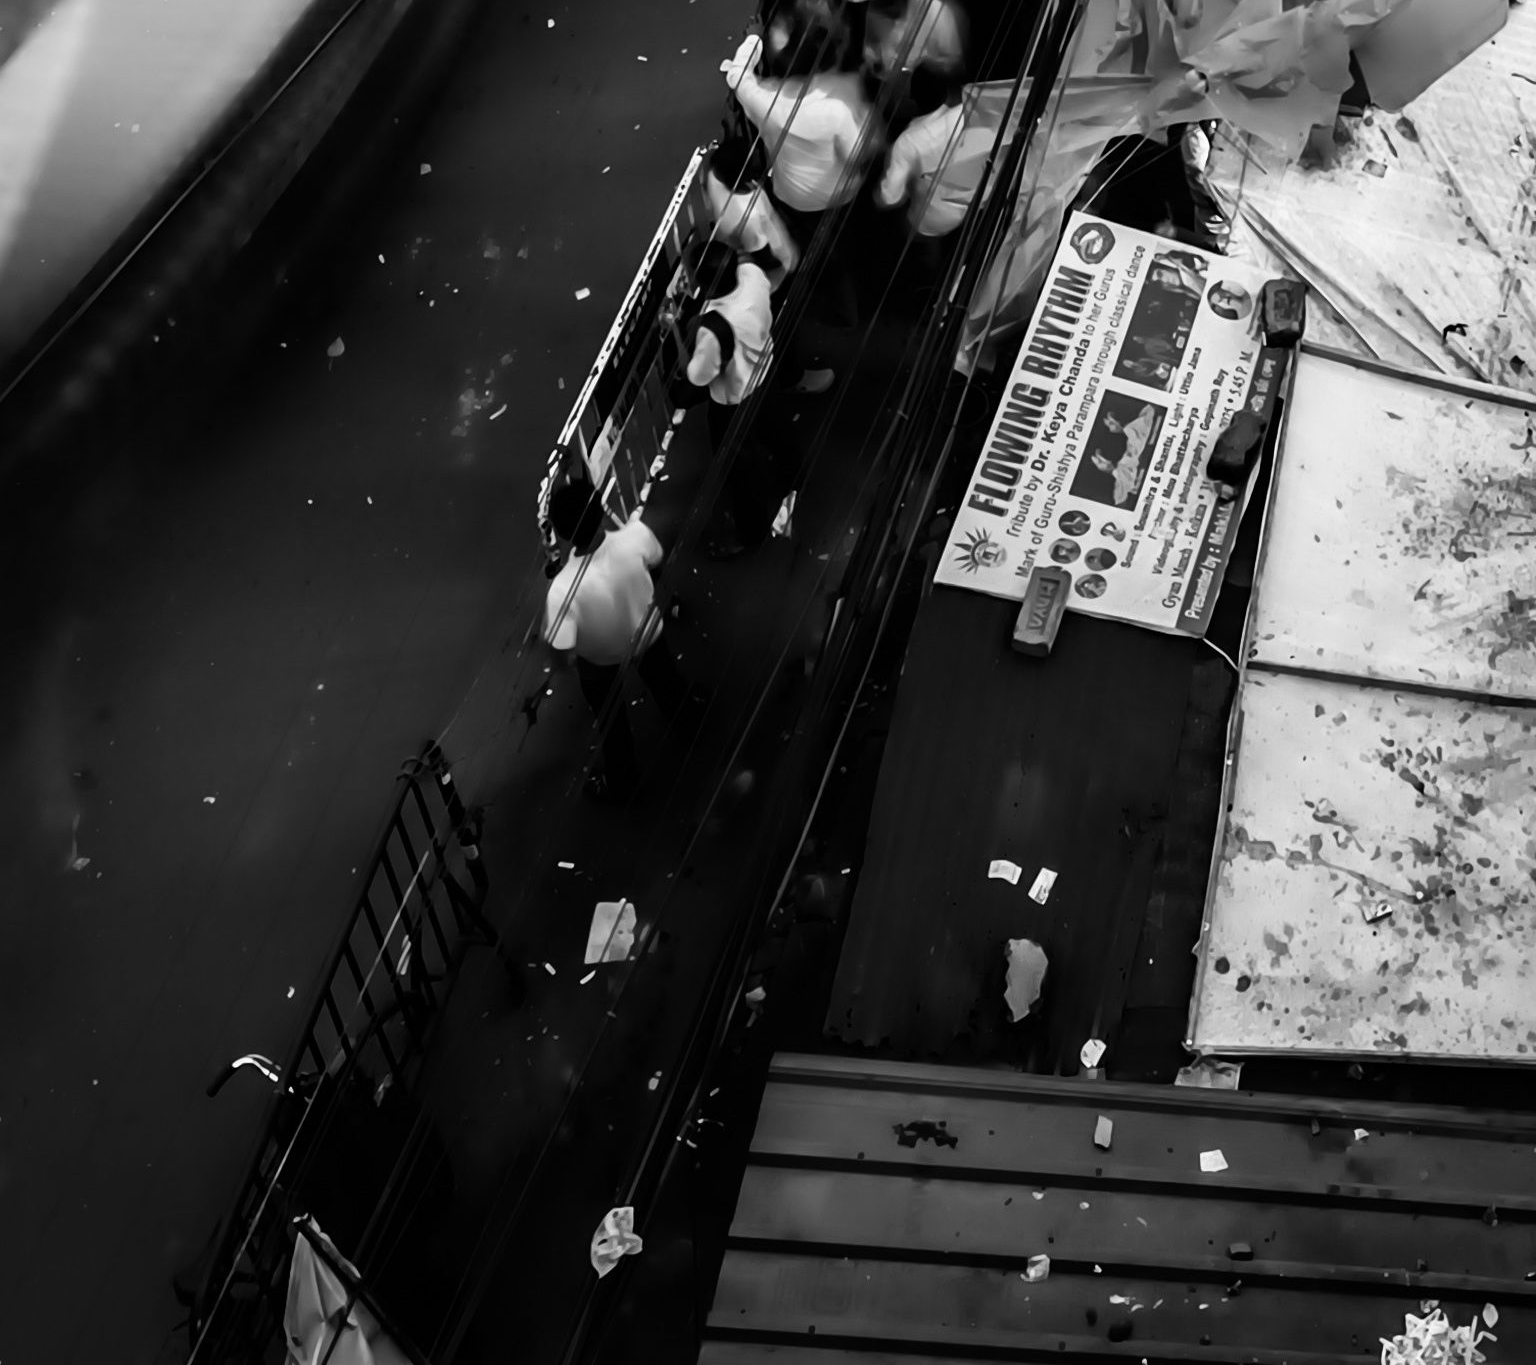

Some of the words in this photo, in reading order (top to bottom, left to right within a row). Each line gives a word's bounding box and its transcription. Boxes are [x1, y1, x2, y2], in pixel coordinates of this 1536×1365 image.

[1124, 244, 1146, 279] dance
[1092, 267, 1116, 302] Gurus
[1107, 278, 1134, 329] classical
[1080, 323, 1096, 336] to
[1084, 301, 1103, 323] her
[1057, 337, 1091, 397] Chanda
[1090, 329, 1118, 375] through
[966, 381, 1053, 518] FLOWING
[1019, 264, 1096, 380] RHYTHM
[1211, 367, 1229, 387] Roy
[1039, 400, 1068, 444] Keya
[1064, 375, 1100, 441] Parampara
[1029, 448, 1051, 473] Dr.
[1149, 475, 1161, 484] &
[1167, 401, 1185, 428] Light
[1167, 406, 1200, 476] Bhattacharya
[1022, 473, 1044, 492] by
[1032, 442, 1077, 529] Guru-Shishya
[1004, 493, 1034, 538] Tribute
[1029, 529, 1044, 545] of
[1013, 547, 1038, 579] Mark
[1160, 580, 1183, 609] Gyan
[1183, 566, 1214, 620] Presented
[1200, 553, 1222, 569] by
